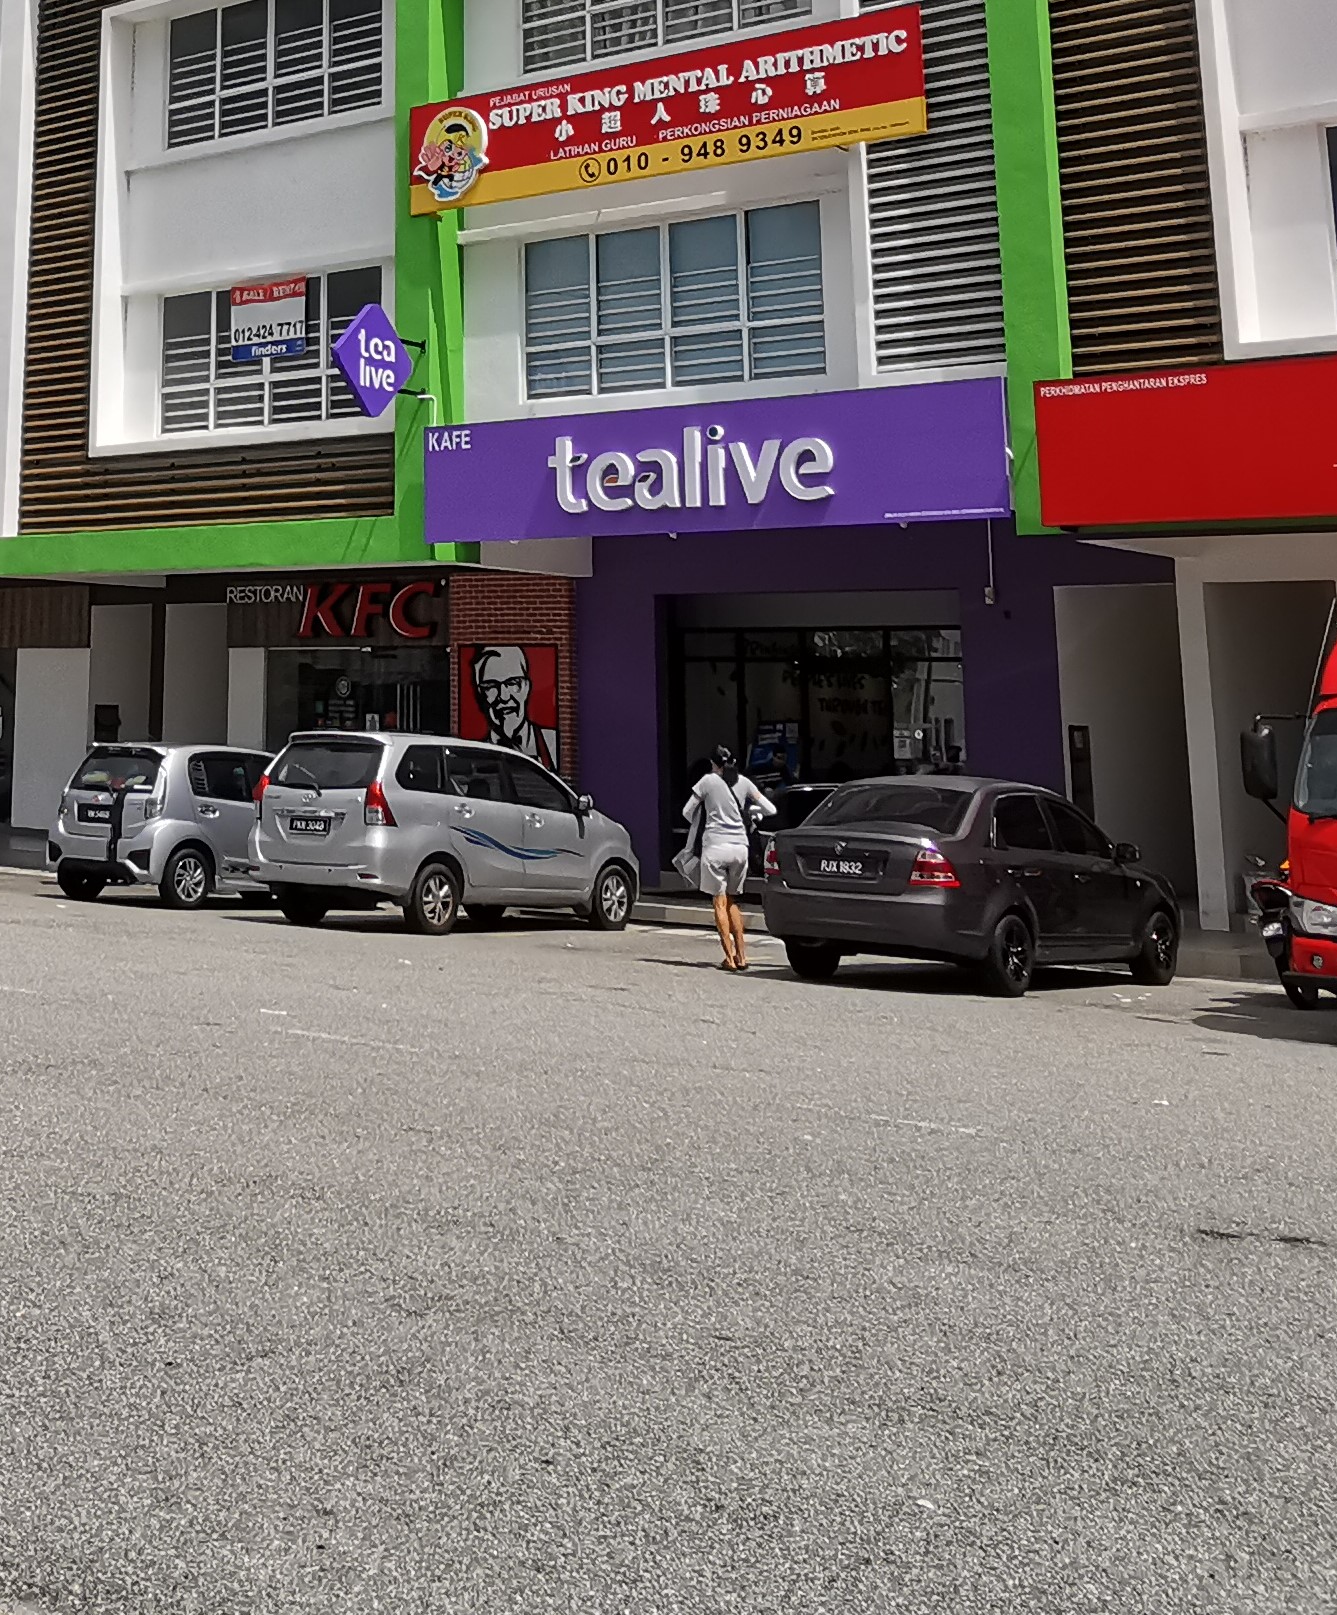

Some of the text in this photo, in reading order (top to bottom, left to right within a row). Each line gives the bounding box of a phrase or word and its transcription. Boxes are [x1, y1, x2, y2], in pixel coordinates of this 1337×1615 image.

[489, 29, 907, 130] SUPER KING MENTAL ARITHMETIC
[489, 84, 571, 107] PEJABAT URUSAN
[658, 99, 840, 141] PERKONGSIAN PERNIAGAAN
[550, 135, 636, 160] LATIHAN GURU
[606, 151, 649, 176] 010
[681, 138, 726, 164] 948
[738, 125, 802, 154] 9349
[358, 329, 396, 362] tea
[359, 357, 396, 392] live
[1101, 378, 1166, 393] PENGHANTARAN
[1168, 373, 1207, 387] EKSPRES
[428, 430, 472, 452] KAFE
[548, 424, 836, 514] tealive
[226, 583, 438, 639] RESTORAN KFC
